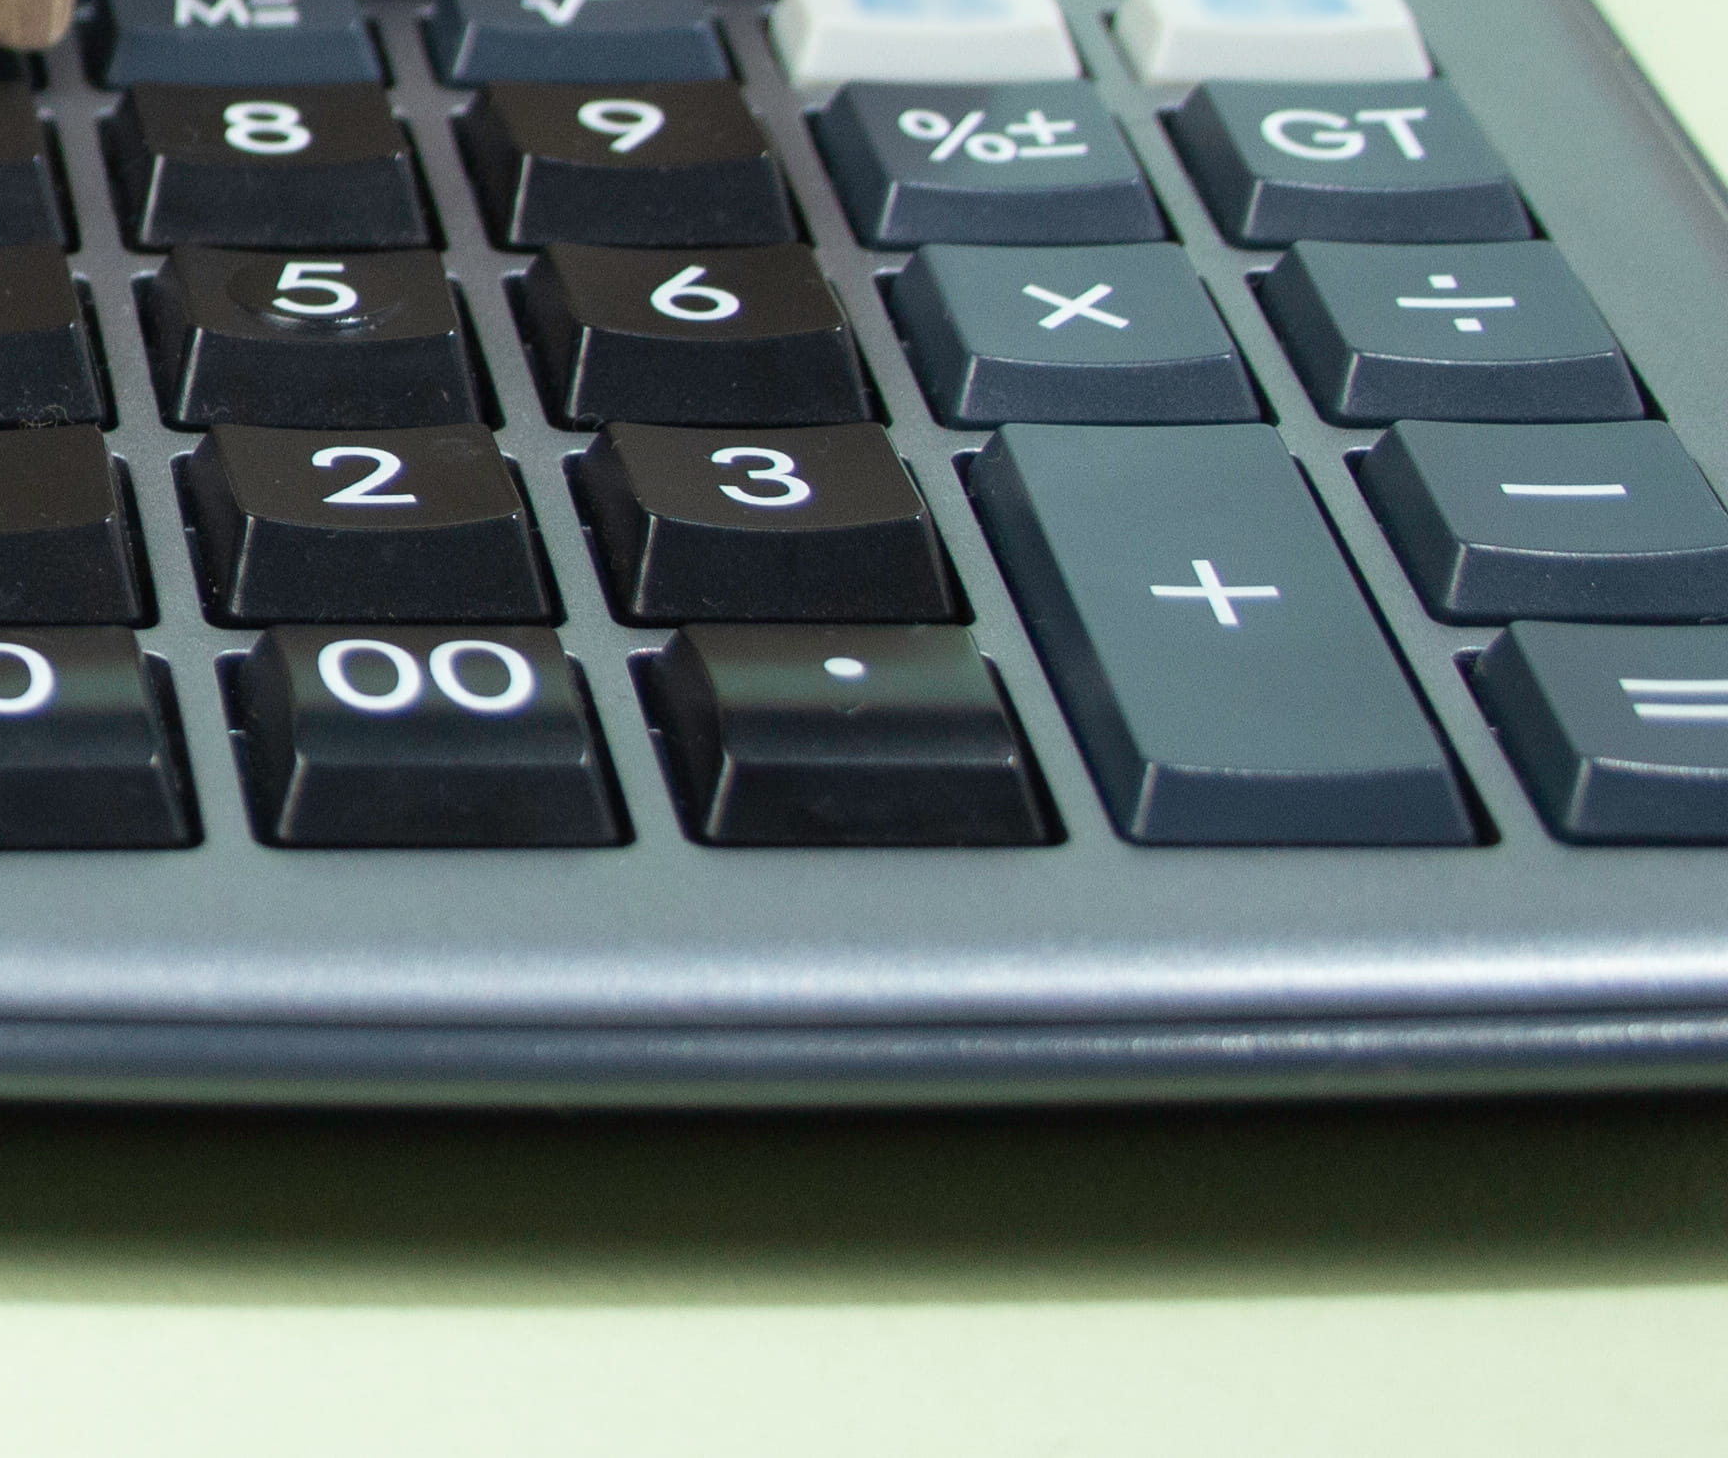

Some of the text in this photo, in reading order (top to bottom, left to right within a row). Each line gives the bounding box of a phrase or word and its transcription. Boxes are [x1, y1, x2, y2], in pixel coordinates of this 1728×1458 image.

[223, 101, 312, 155] 8
[577, 99, 666, 153] 9
[1261, 106, 1428, 161] GT
[271, 261, 359, 316] 5
[649, 264, 741, 322] 6
[310, 445, 418, 505] 2
[710, 445, 812, 508] 3
[1149, 558, 1281, 627] +
[316, 638, 536, 714] 00
